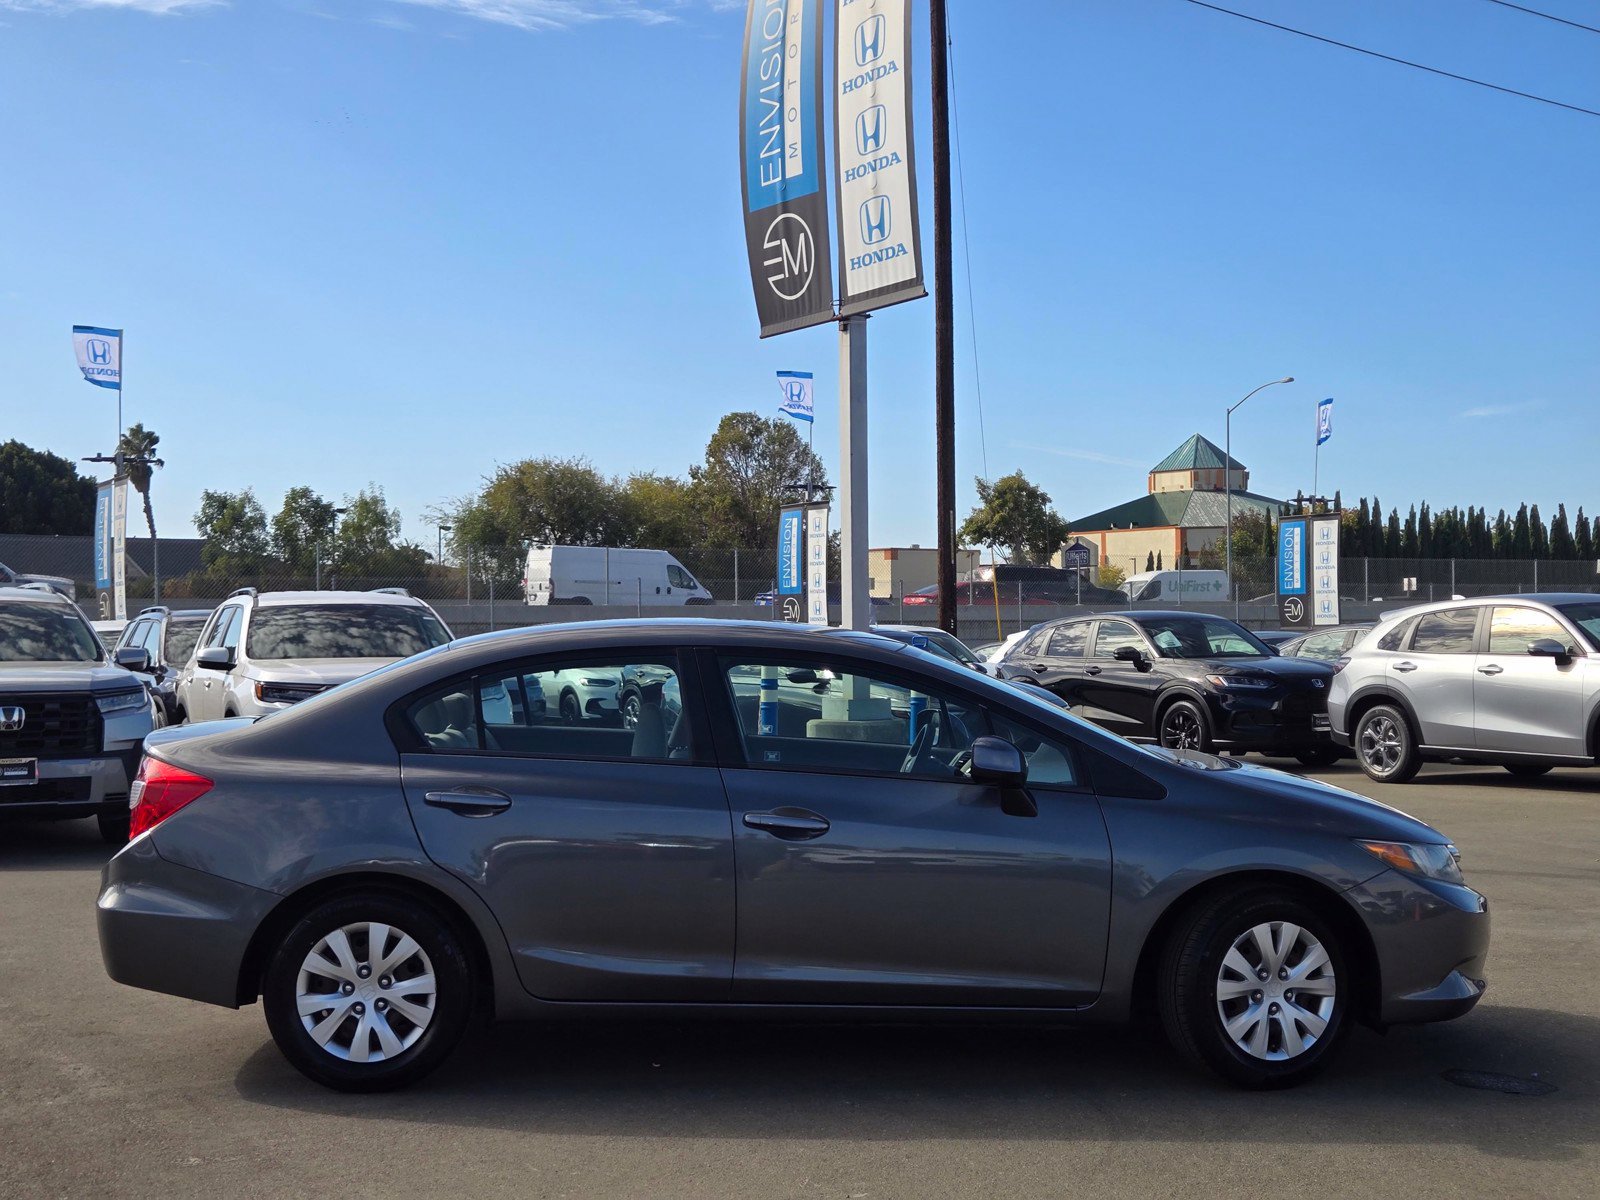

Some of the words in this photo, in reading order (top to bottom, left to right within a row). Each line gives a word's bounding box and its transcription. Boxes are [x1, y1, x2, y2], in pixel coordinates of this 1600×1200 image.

[760, 0, 784, 187] ENVISIO
[842, 60, 899, 95] HONDA
[844, 152, 902, 183] HONDA
[850, 242, 908, 271] HONDA
[783, 518, 792, 588] ENVISION
[1284, 527, 1294, 589] ENVISION
